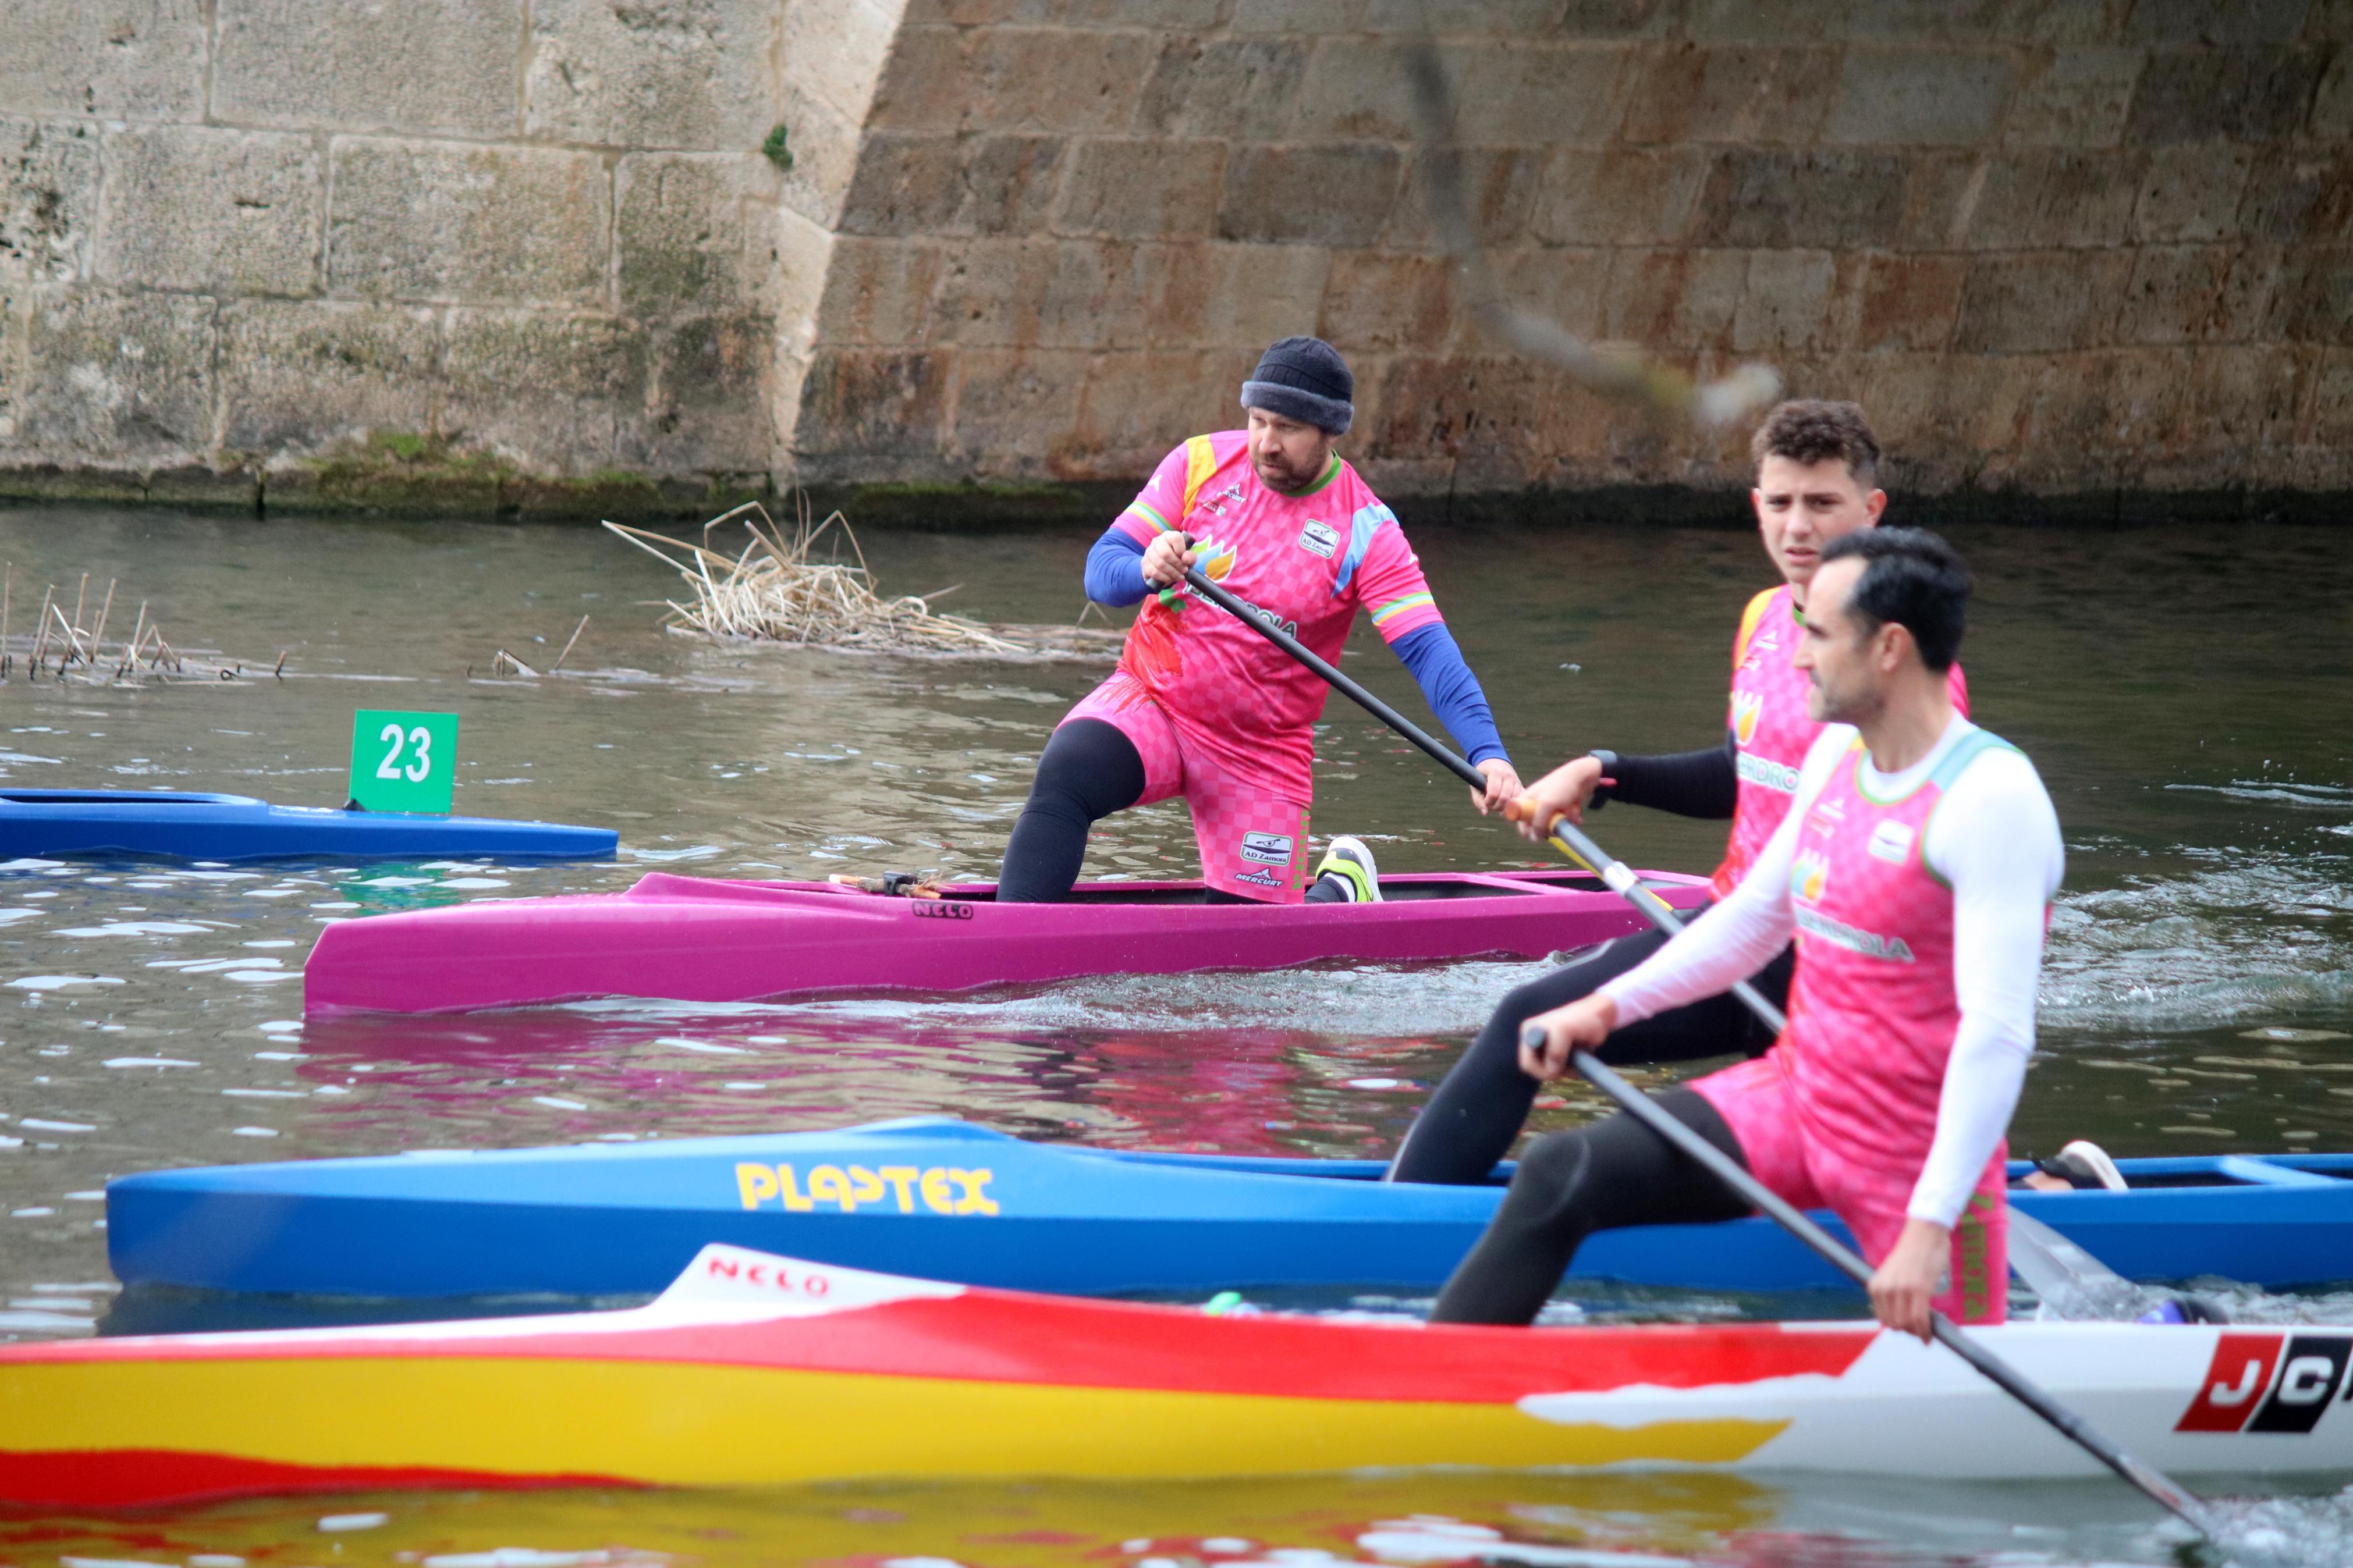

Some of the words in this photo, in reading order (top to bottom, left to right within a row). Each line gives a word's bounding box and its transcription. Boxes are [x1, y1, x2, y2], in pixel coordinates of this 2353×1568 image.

[376, 723, 432, 783] 23
[1259, 854, 1286, 862] Zamora
[1235, 873, 1283, 887] MERCURY
[914, 902, 973, 919] NELO
[736, 1162, 999, 1216] PLASTEX
[709, 1258, 829, 1297] NELO
